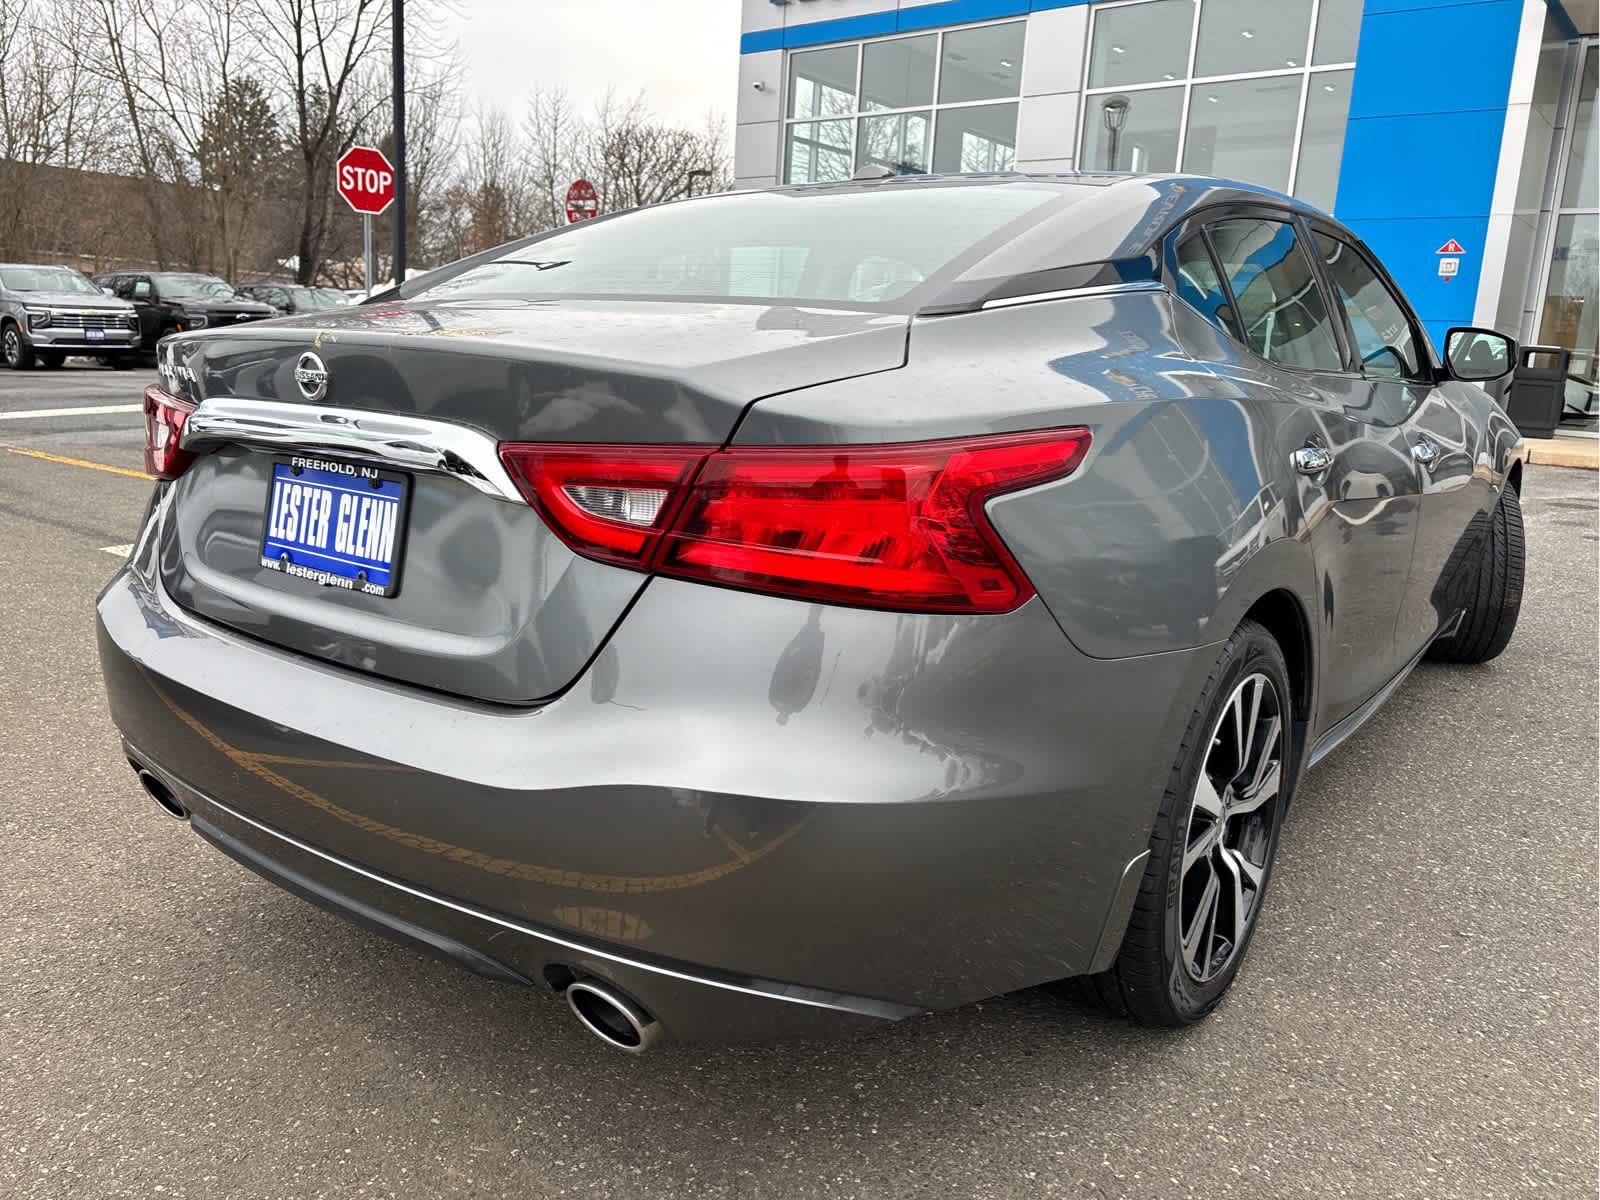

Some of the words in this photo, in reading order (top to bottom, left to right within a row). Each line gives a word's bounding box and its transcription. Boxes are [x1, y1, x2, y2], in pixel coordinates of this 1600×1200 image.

[342, 165, 392, 195] STOP
[291, 457, 358, 478] FREEHOLD,
[361, 467, 379, 479] NJ
[269, 482, 332, 549] LESTER
[335, 494, 398, 563] GLENN
